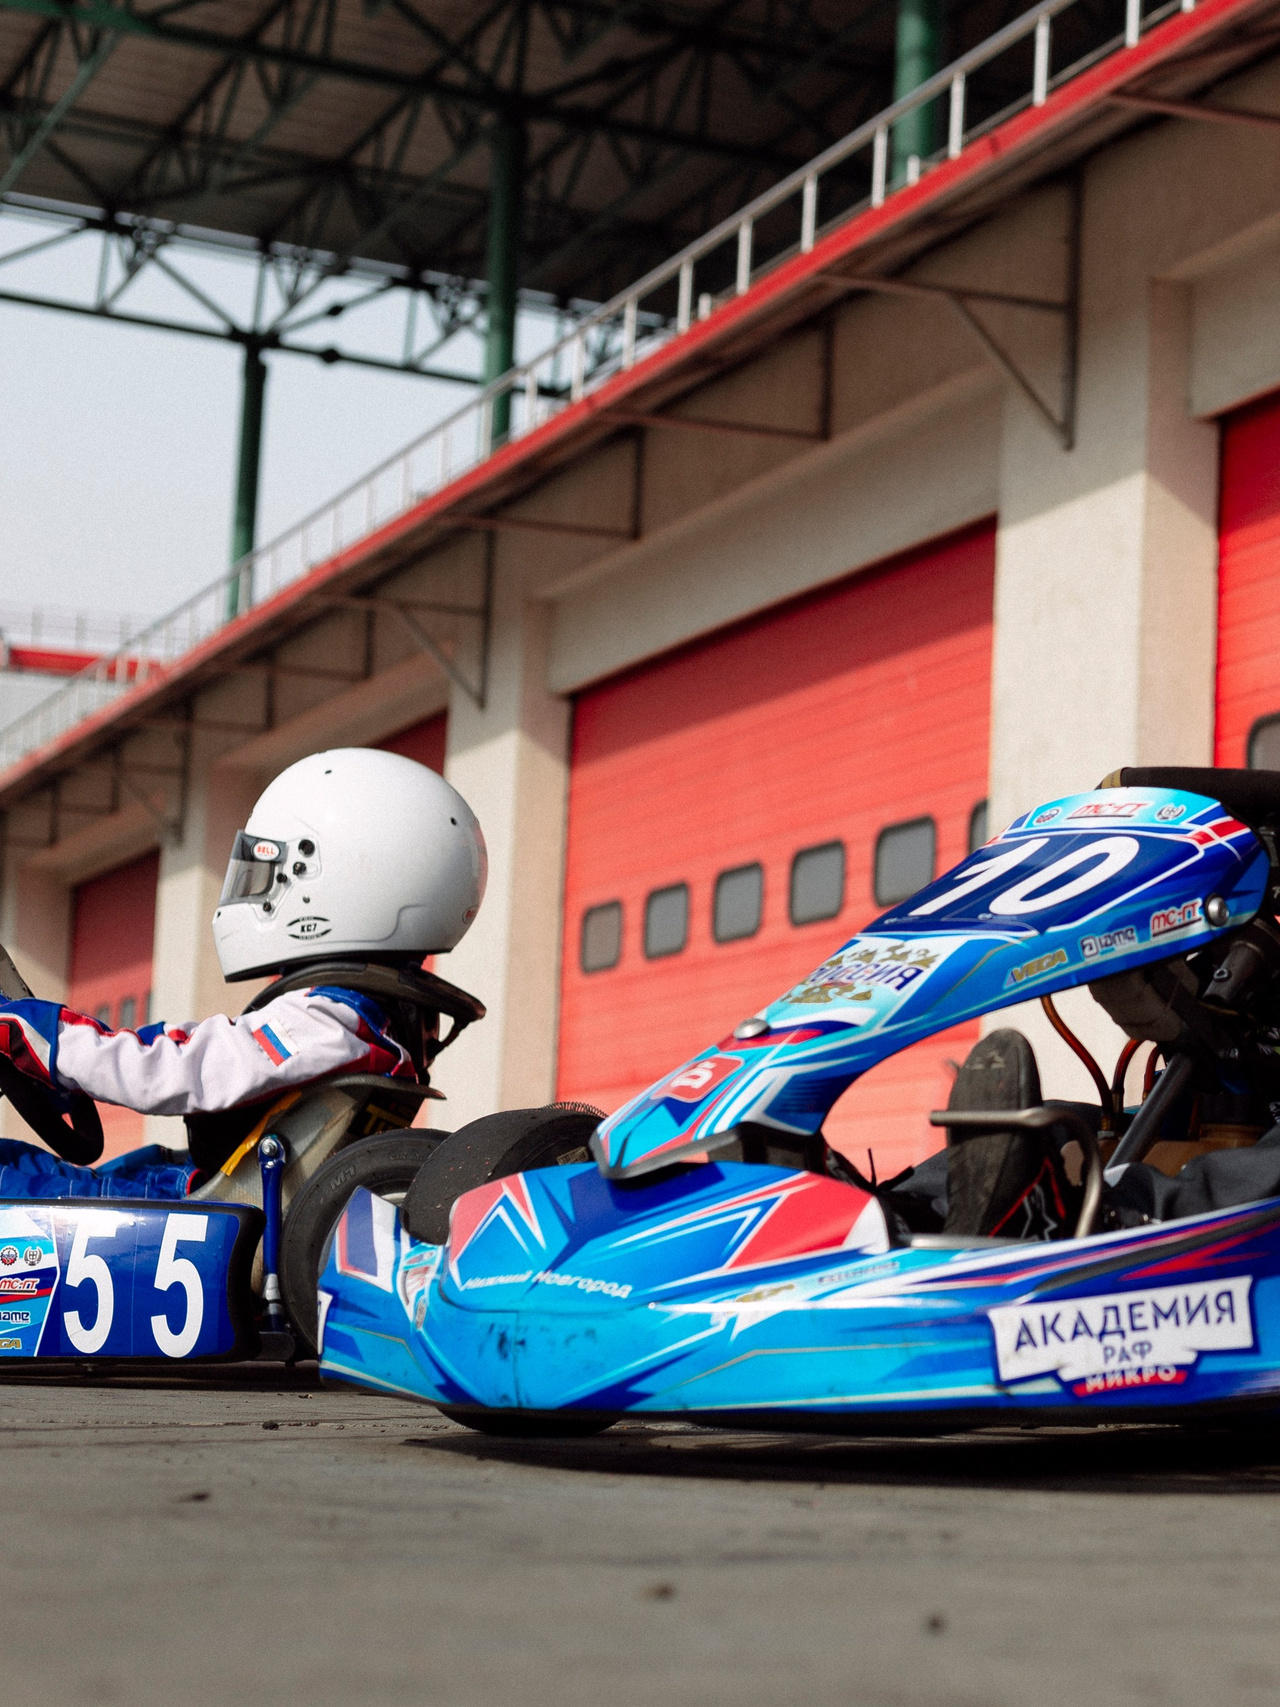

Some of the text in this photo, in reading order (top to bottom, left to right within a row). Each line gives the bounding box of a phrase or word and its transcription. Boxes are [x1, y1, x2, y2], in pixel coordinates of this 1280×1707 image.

[908, 836, 1140, 916] 10
[300, 923, 318, 933] KC7
[1012, 950, 1067, 982] VEGA
[63, 1213, 208, 1358] 55
[532, 1269, 632, 1299] Новгород
[1014, 1289, 1237, 1353] АКАДЕМИЯ
[1103, 1341, 1153, 1365] РАФ
[1085, 1364, 1178, 1394] МИКРО
